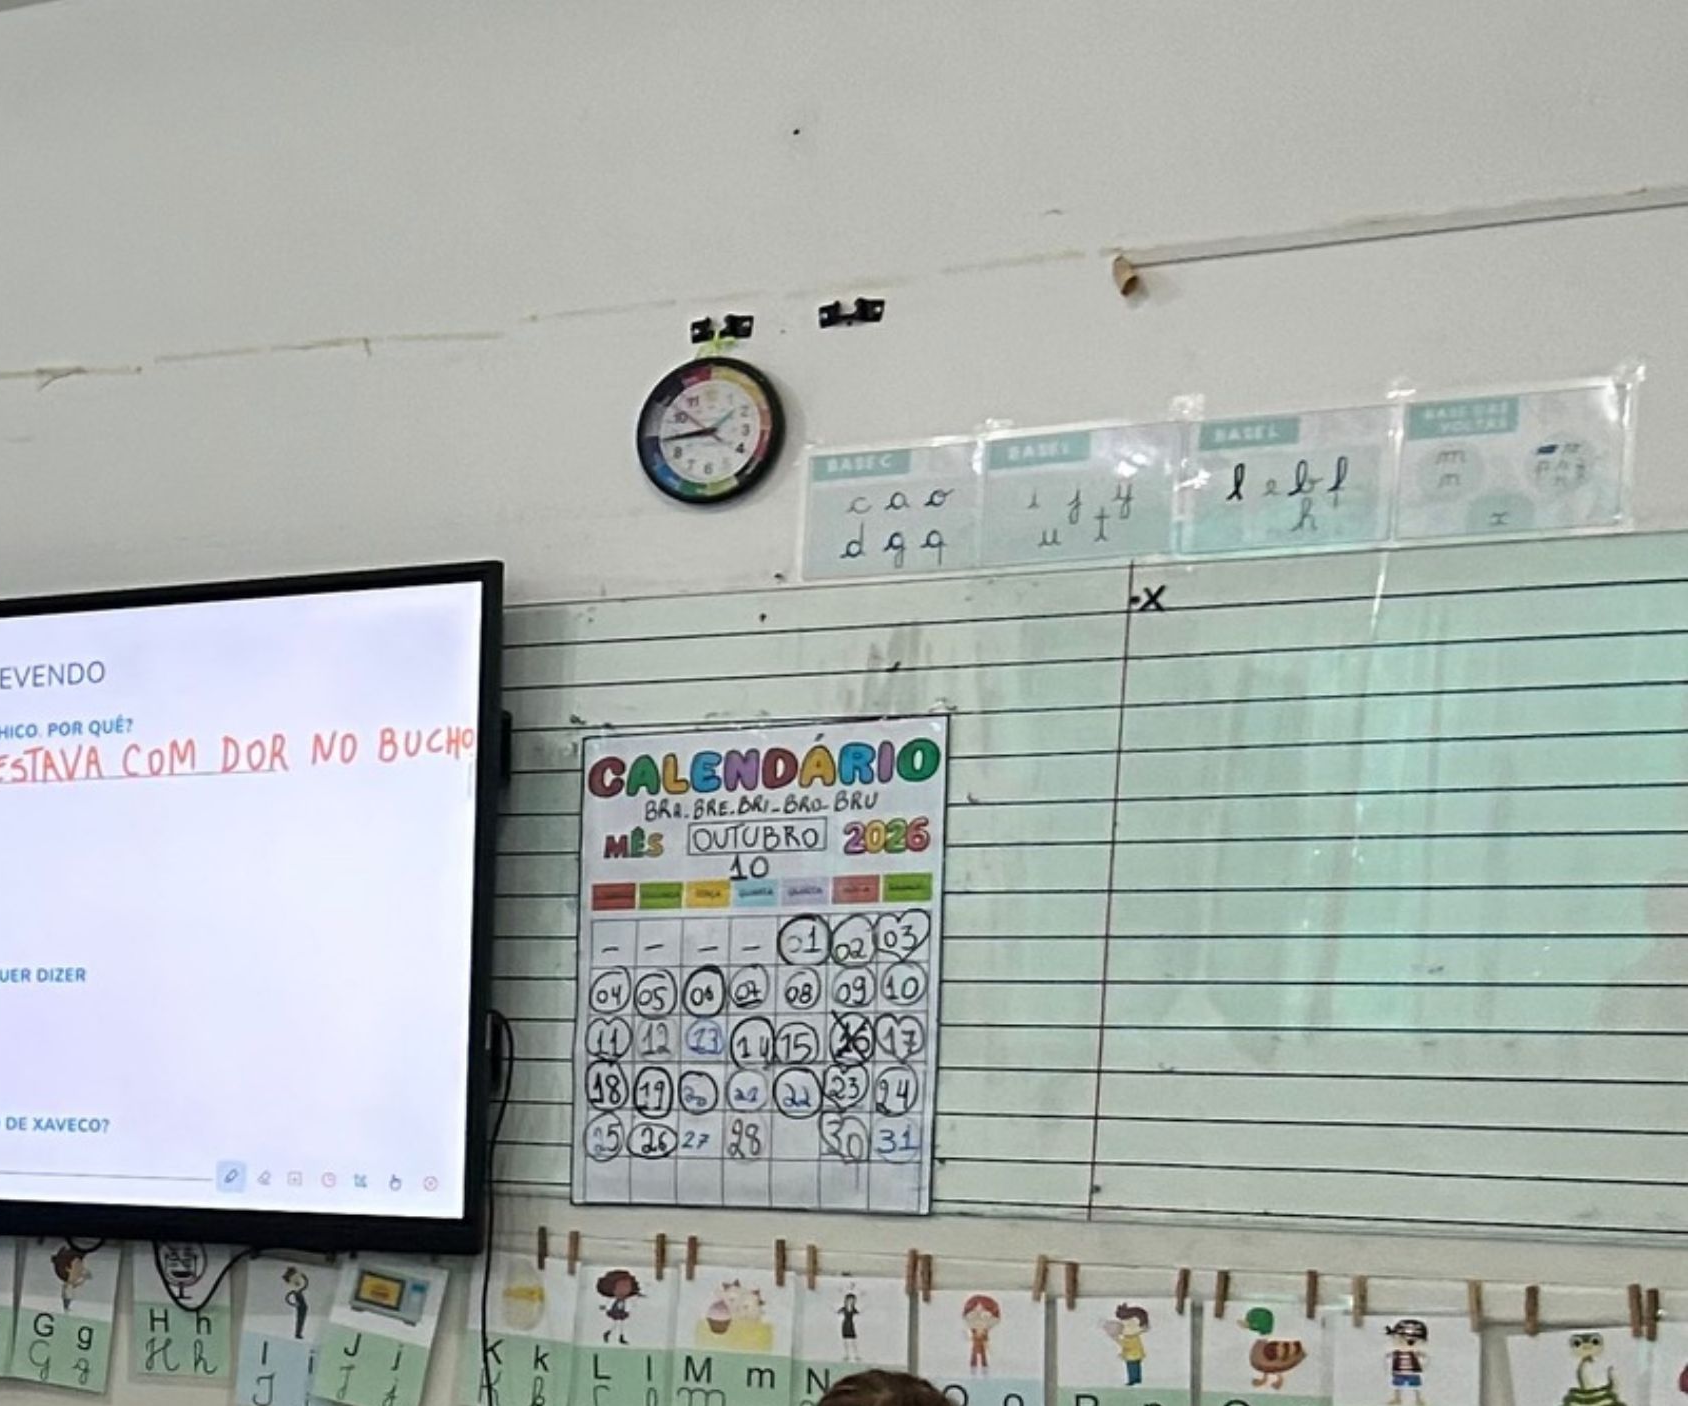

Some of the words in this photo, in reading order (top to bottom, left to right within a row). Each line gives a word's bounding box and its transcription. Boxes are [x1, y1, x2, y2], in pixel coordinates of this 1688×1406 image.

[48, 720, 83, 737] POR
[88, 713, 134, 737] QUÊ?
[122, 738, 196, 779] COM
[221, 733, 289, 773] DOR
[311, 731, 358, 765] NO
[589, 733, 941, 798] CALENDÁRIO
[603, 825, 664, 858] MÊS
[692, 823, 820, 852] OUTUBRO
[843, 816, 930, 855] 2026
[729, 853, 770, 881] 10
[835, 938, 865, 962] 02
[884, 925, 916, 949] 03
[36, 967, 87, 983] DIZER
[785, 982, 813, 1002] 08
[837, 979, 867, 1004] 09
[886, 977, 919, 1000] 10
[6, 1116, 27, 1131] DE
[33, 1117, 110, 1133] XAVECO?
[640, 1129, 668, 1154] 26
[682, 1130, 710, 1149] 27
[875, 1129, 918, 1154] 31
[33, 1312, 55, 1338] G
[77, 1323, 94, 1350] g
[684, 1356, 713, 1385] M
[746, 1366, 776, 1389] m
